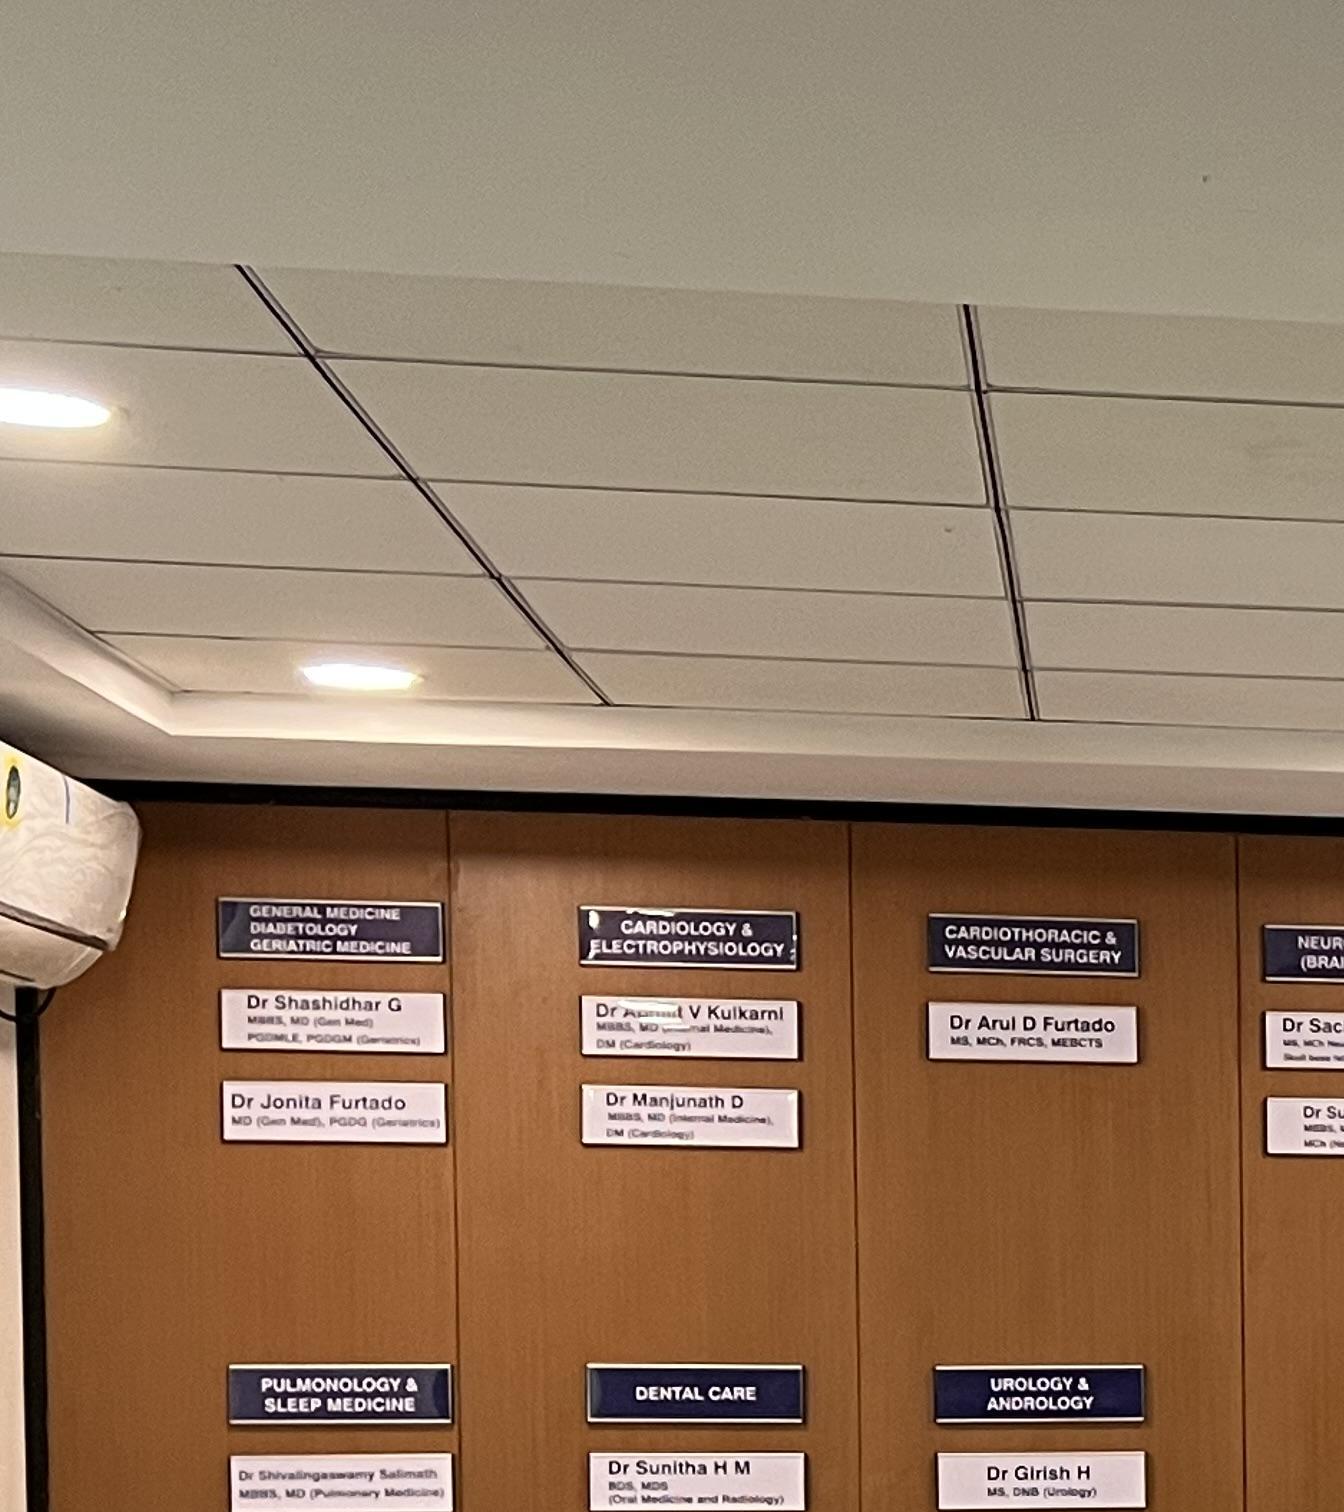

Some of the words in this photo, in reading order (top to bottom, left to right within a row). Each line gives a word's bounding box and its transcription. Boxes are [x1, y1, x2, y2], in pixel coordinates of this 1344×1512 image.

[250, 905, 321, 919] GENERAL
[326, 907, 400, 920] MEDICINE
[250, 922, 358, 936] DIABETOLOGY
[621, 921, 736, 936] CARDIOLOGY
[741, 923, 752, 936] &
[945, 925, 1100, 944] CARDIOTHORACIC
[1105, 932, 1117, 945] &
[250, 939, 333, 952] GERIATRIC
[337, 941, 412, 954] MEDICINE
[590, 939, 784, 957] ELECTROPHYSIOLOGY
[945, 945, 1036, 961] VASCULAR
[1040, 948, 1122, 964] SURGERY
[248, 995, 267, 1009] Dr
[275, 995, 381, 1012] Shashidhar
[388, 998, 402, 1012] G
[596, 1004, 617, 1017] Dr
[689, 1005, 701, 1019] V
[708, 1006, 784, 1021] Kulkarni
[951, 1015, 971, 1030] Dr
[977, 1016, 1016, 1030] Arul
[1024, 1017, 1036, 1031] D
[1043, 1017, 1115, 1033] Furtado
[1283, 1018, 1303, 1032] Dr
[232, 1094, 254, 1109] Dr
[260, 1094, 322, 1109] Jonita
[330, 1095, 406, 1110] Furtado
[606, 1092, 626, 1106] Dr
[632, 1093, 724, 1110] Manjunath
[732, 1095, 743, 1108] D
[1303, 1106, 1321, 1119] Dr
[261, 1377, 401, 1392] PULMONOLOGY
[405, 1378, 418, 1392] &
[990, 1377, 1073, 1392] UROLOGY
[1078, 1378, 1089, 1391] &
[635, 1386, 704, 1401] DENTAL
[708, 1386, 756, 1401] CARE
[264, 1398, 322, 1412] SLEEP
[327, 1398, 416, 1412] MEDICINE
[987, 1396, 1094, 1411] ANDROLOGY
[609, 1461, 630, 1475] Dr
[636, 1461, 708, 1475] Sunitha
[714, 1461, 727, 1475] H
[735, 1461, 750, 1475] M
[987, 1466, 1008, 1481] Dr
[1014, 1465, 1070, 1480] Girish
[1078, 1466, 1090, 1479] H
[239, 1471, 253, 1481] Dr
